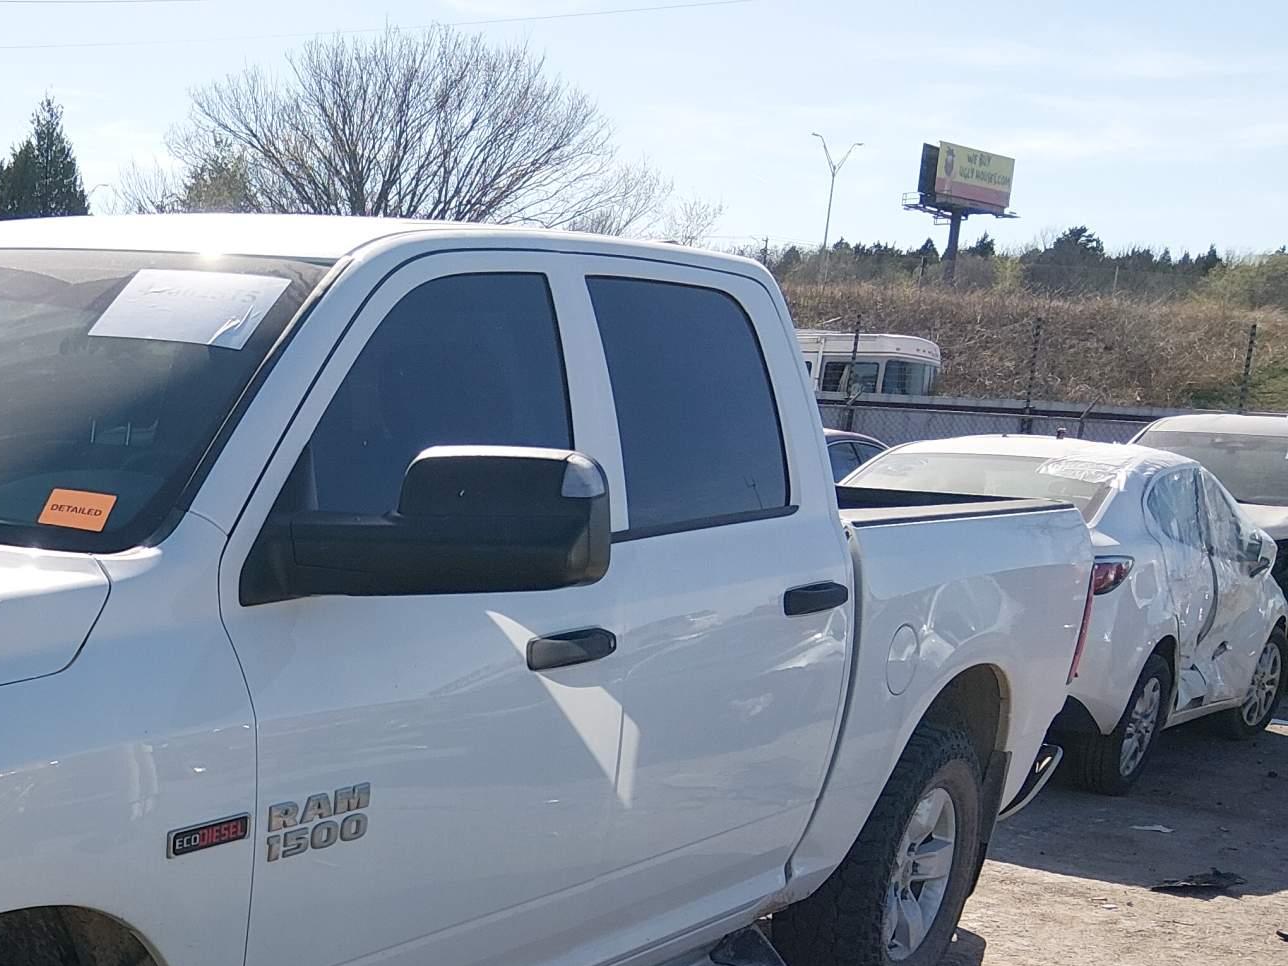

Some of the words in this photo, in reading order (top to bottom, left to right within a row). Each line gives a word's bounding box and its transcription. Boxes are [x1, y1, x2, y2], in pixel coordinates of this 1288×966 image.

[50, 503, 103, 517] DETAILED
[267, 782, 371, 832] RAM
[174, 822, 246, 850] ECODIESEL
[266, 813, 369, 862] 1500
